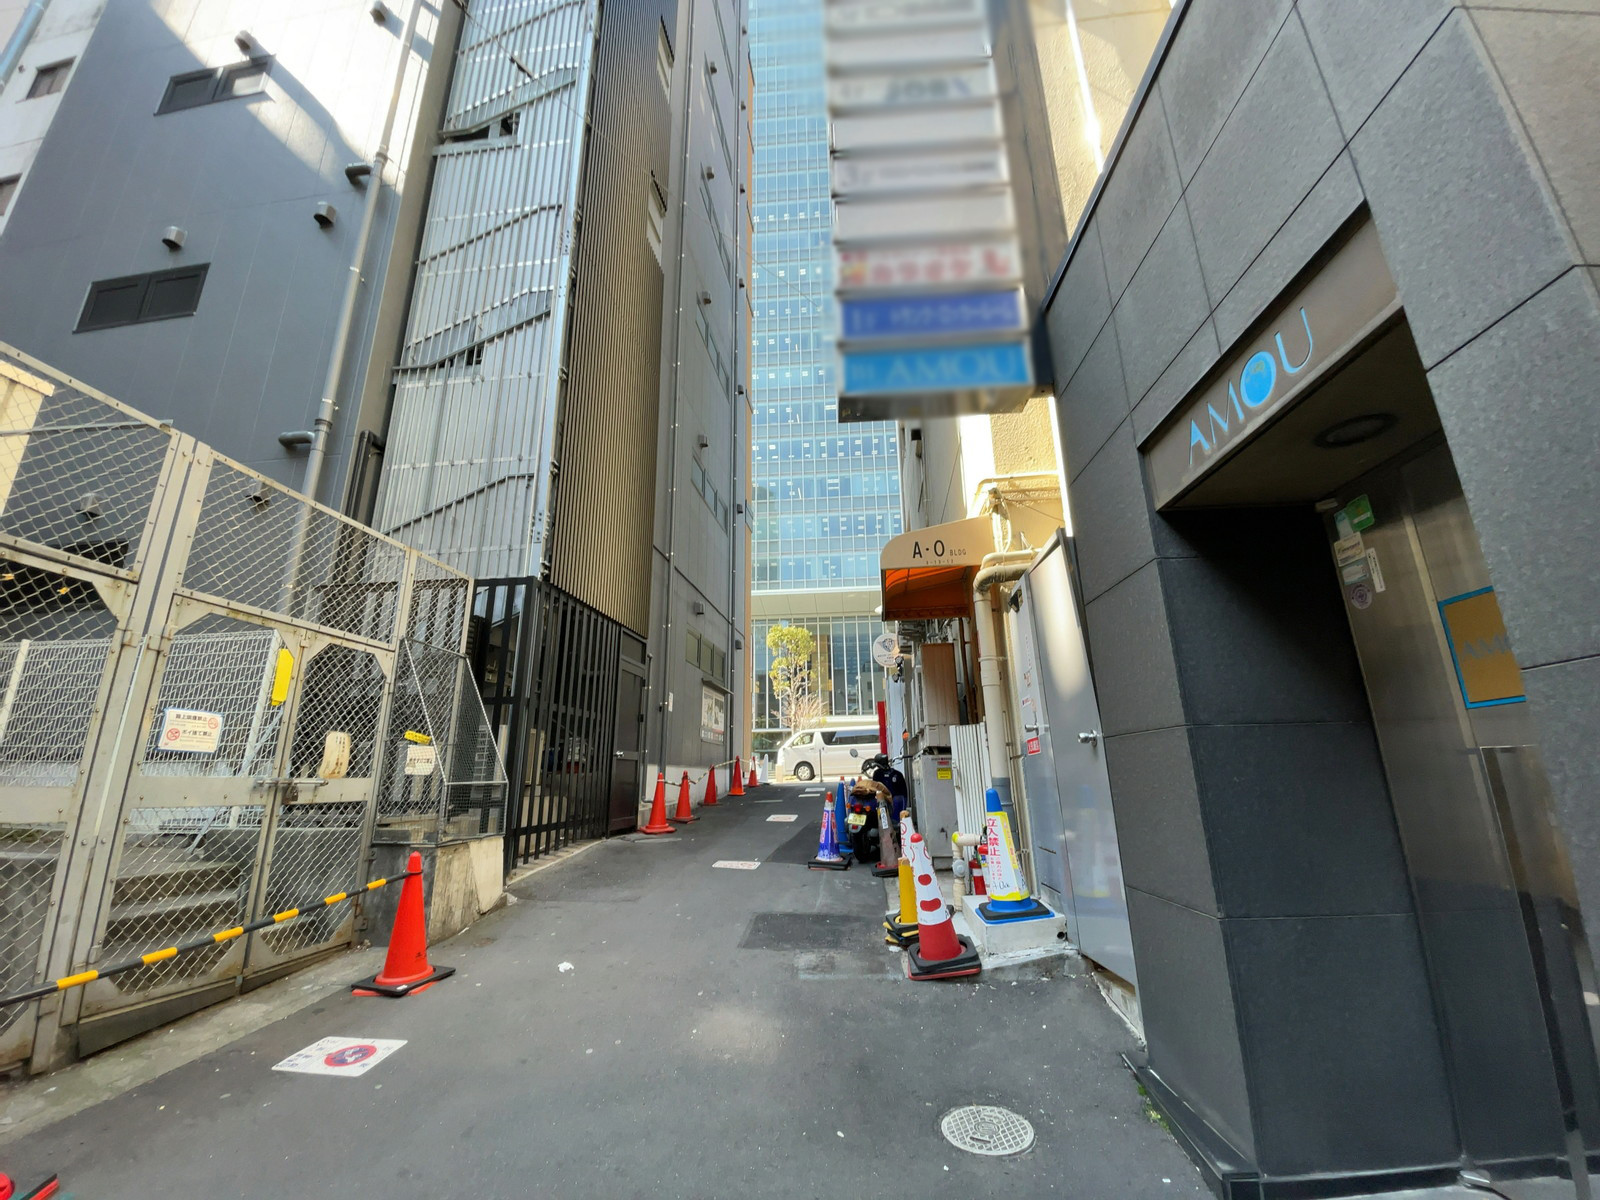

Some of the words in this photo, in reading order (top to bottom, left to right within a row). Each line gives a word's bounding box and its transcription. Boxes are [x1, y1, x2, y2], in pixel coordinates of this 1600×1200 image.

[886, 350, 1018, 386] AMOU
[1189, 306, 1313, 466] AMOU
[986, 817, 1001, 857] 立入禁止
